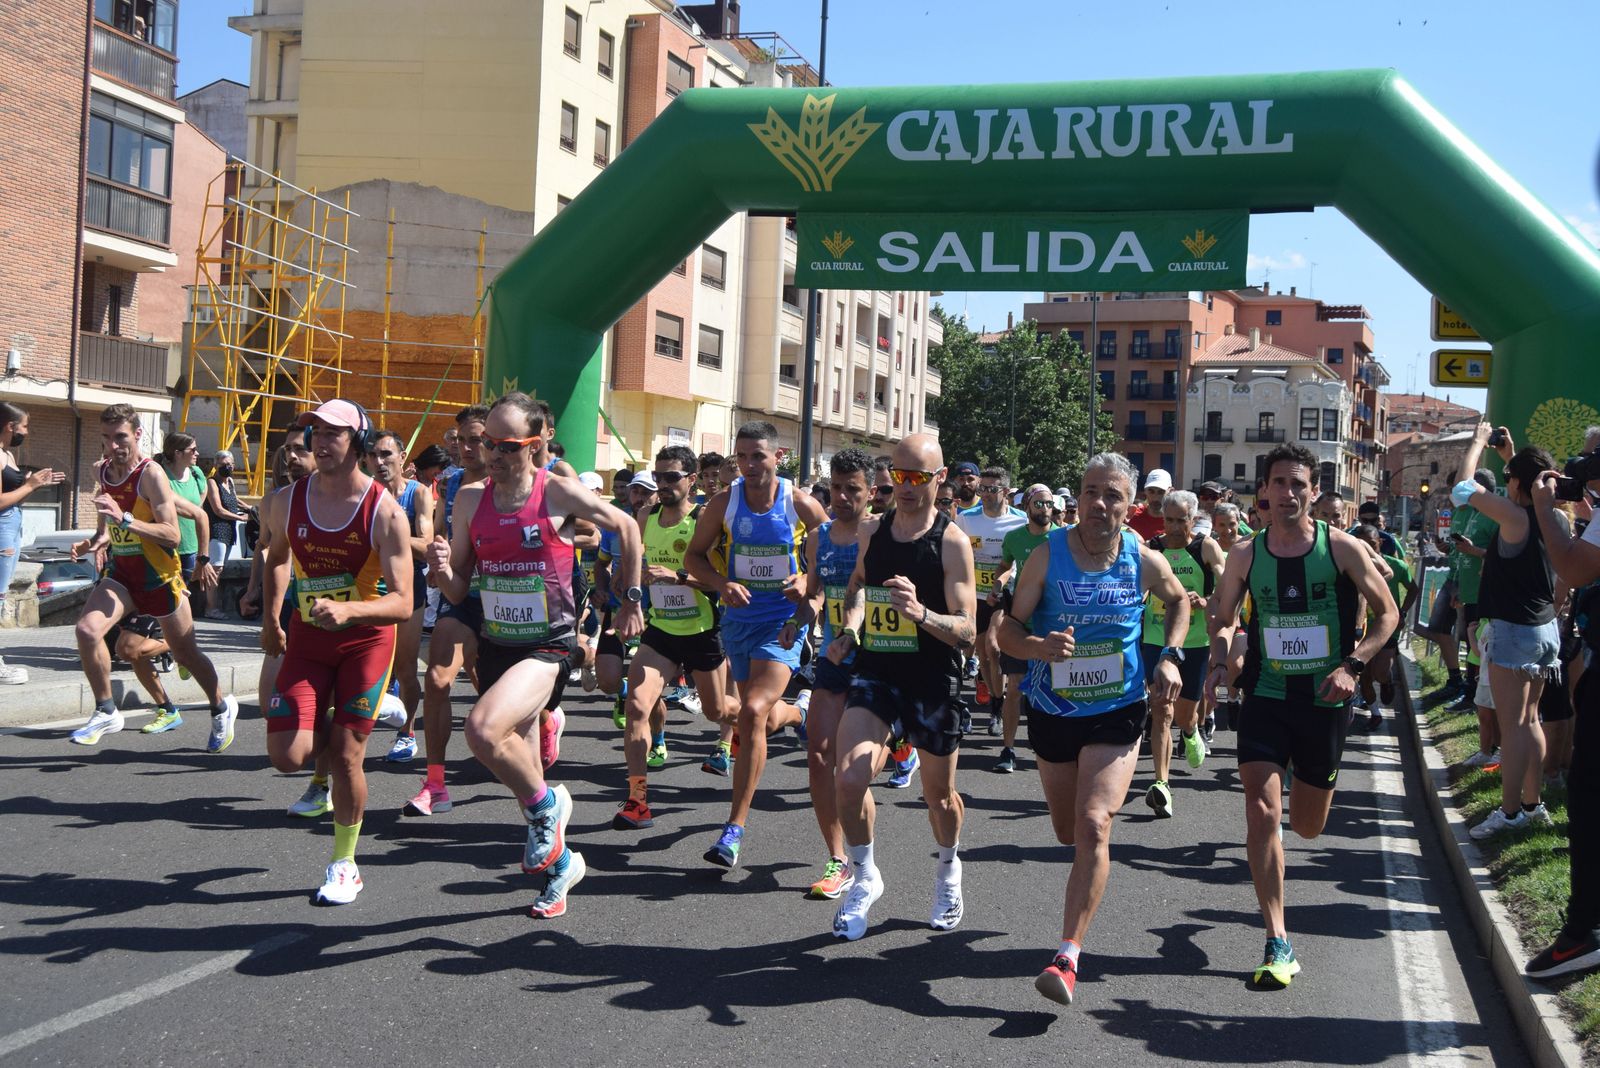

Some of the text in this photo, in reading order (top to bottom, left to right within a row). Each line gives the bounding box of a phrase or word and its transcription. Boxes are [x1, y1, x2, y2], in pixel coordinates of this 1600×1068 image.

[886, 100, 1293, 164] CAJA RURAL
[876, 230, 1154, 273] SALIDA
[810, 261, 864, 271] CAJA RURAL
[1168, 261, 1229, 271] CAJA RURAL
[482, 559, 546, 572] Fisiorama
[750, 565, 774, 577] CODE
[1172, 566, 1194, 575] ALORIO
[663, 595, 686, 607] JORGE
[1097, 590, 1137, 606] ULSA
[494, 605, 533, 622] GARGAR
[833, 602, 842, 623] 1
[870, 606, 900, 632] 49
[1057, 613, 1129, 625] ATLETISMO
[518, 627, 545, 635] RURAL
[1282, 637, 1309, 655] PEÓN
[1302, 661, 1326, 669] RURAL
[1069, 669, 1108, 687] MANSO
[1094, 687, 1120, 697] RURAL
